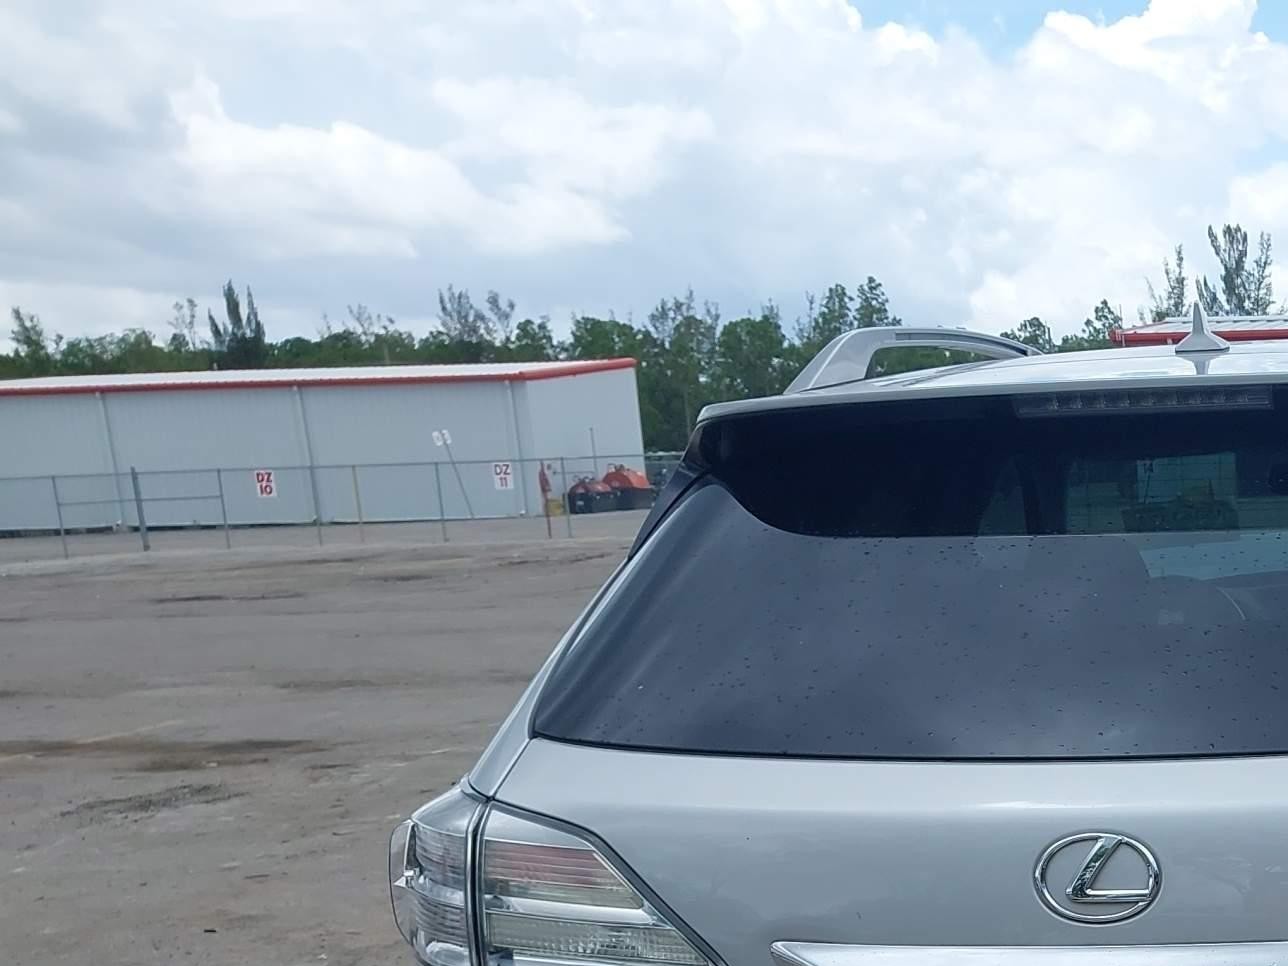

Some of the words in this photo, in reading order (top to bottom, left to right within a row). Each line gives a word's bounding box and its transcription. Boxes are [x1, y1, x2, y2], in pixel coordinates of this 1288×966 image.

[494, 464, 511, 476] DZ
[256, 471, 273, 483] DZ
[499, 477, 508, 488] 11
[260, 484, 273, 496] 10
